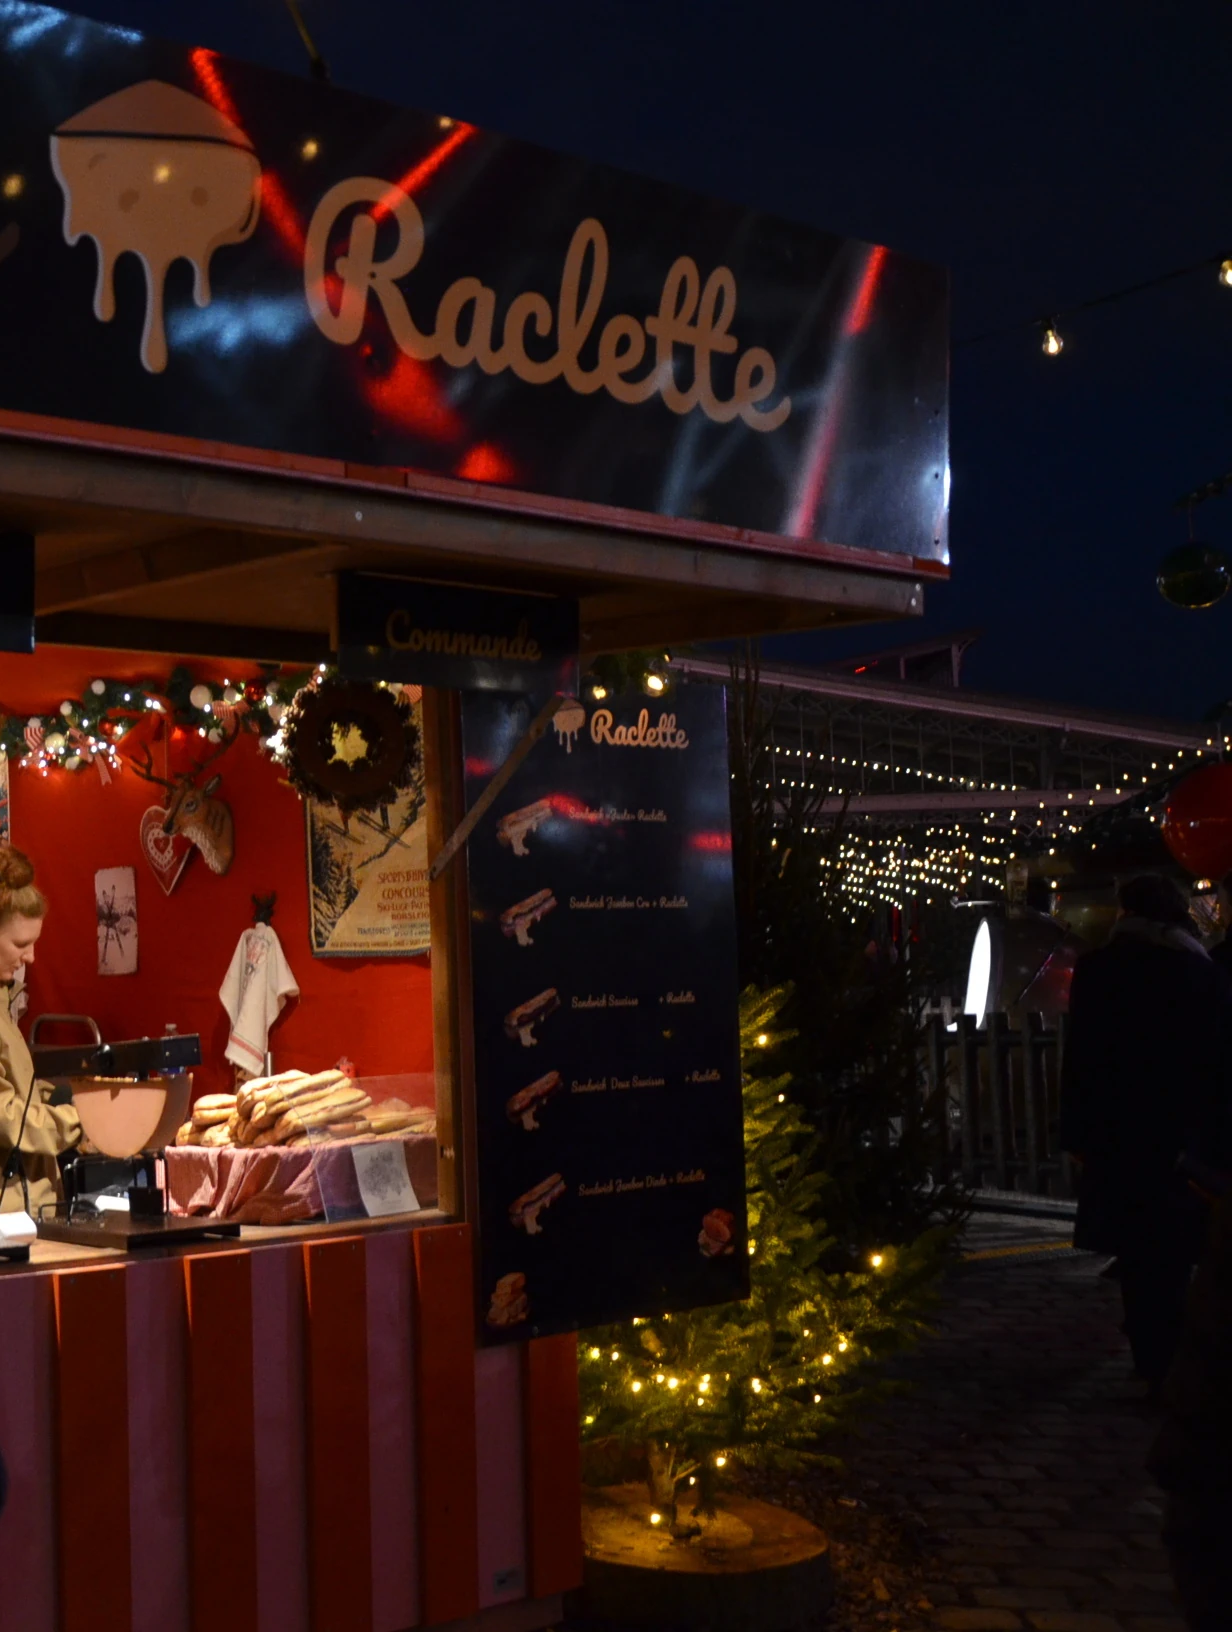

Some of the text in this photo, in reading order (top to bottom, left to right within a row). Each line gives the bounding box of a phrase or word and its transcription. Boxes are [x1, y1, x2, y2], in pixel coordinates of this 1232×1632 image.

[305, 175, 792, 432] Raclette
[384, 608, 543, 661] Commande
[590, 707, 689, 750] Raclette
